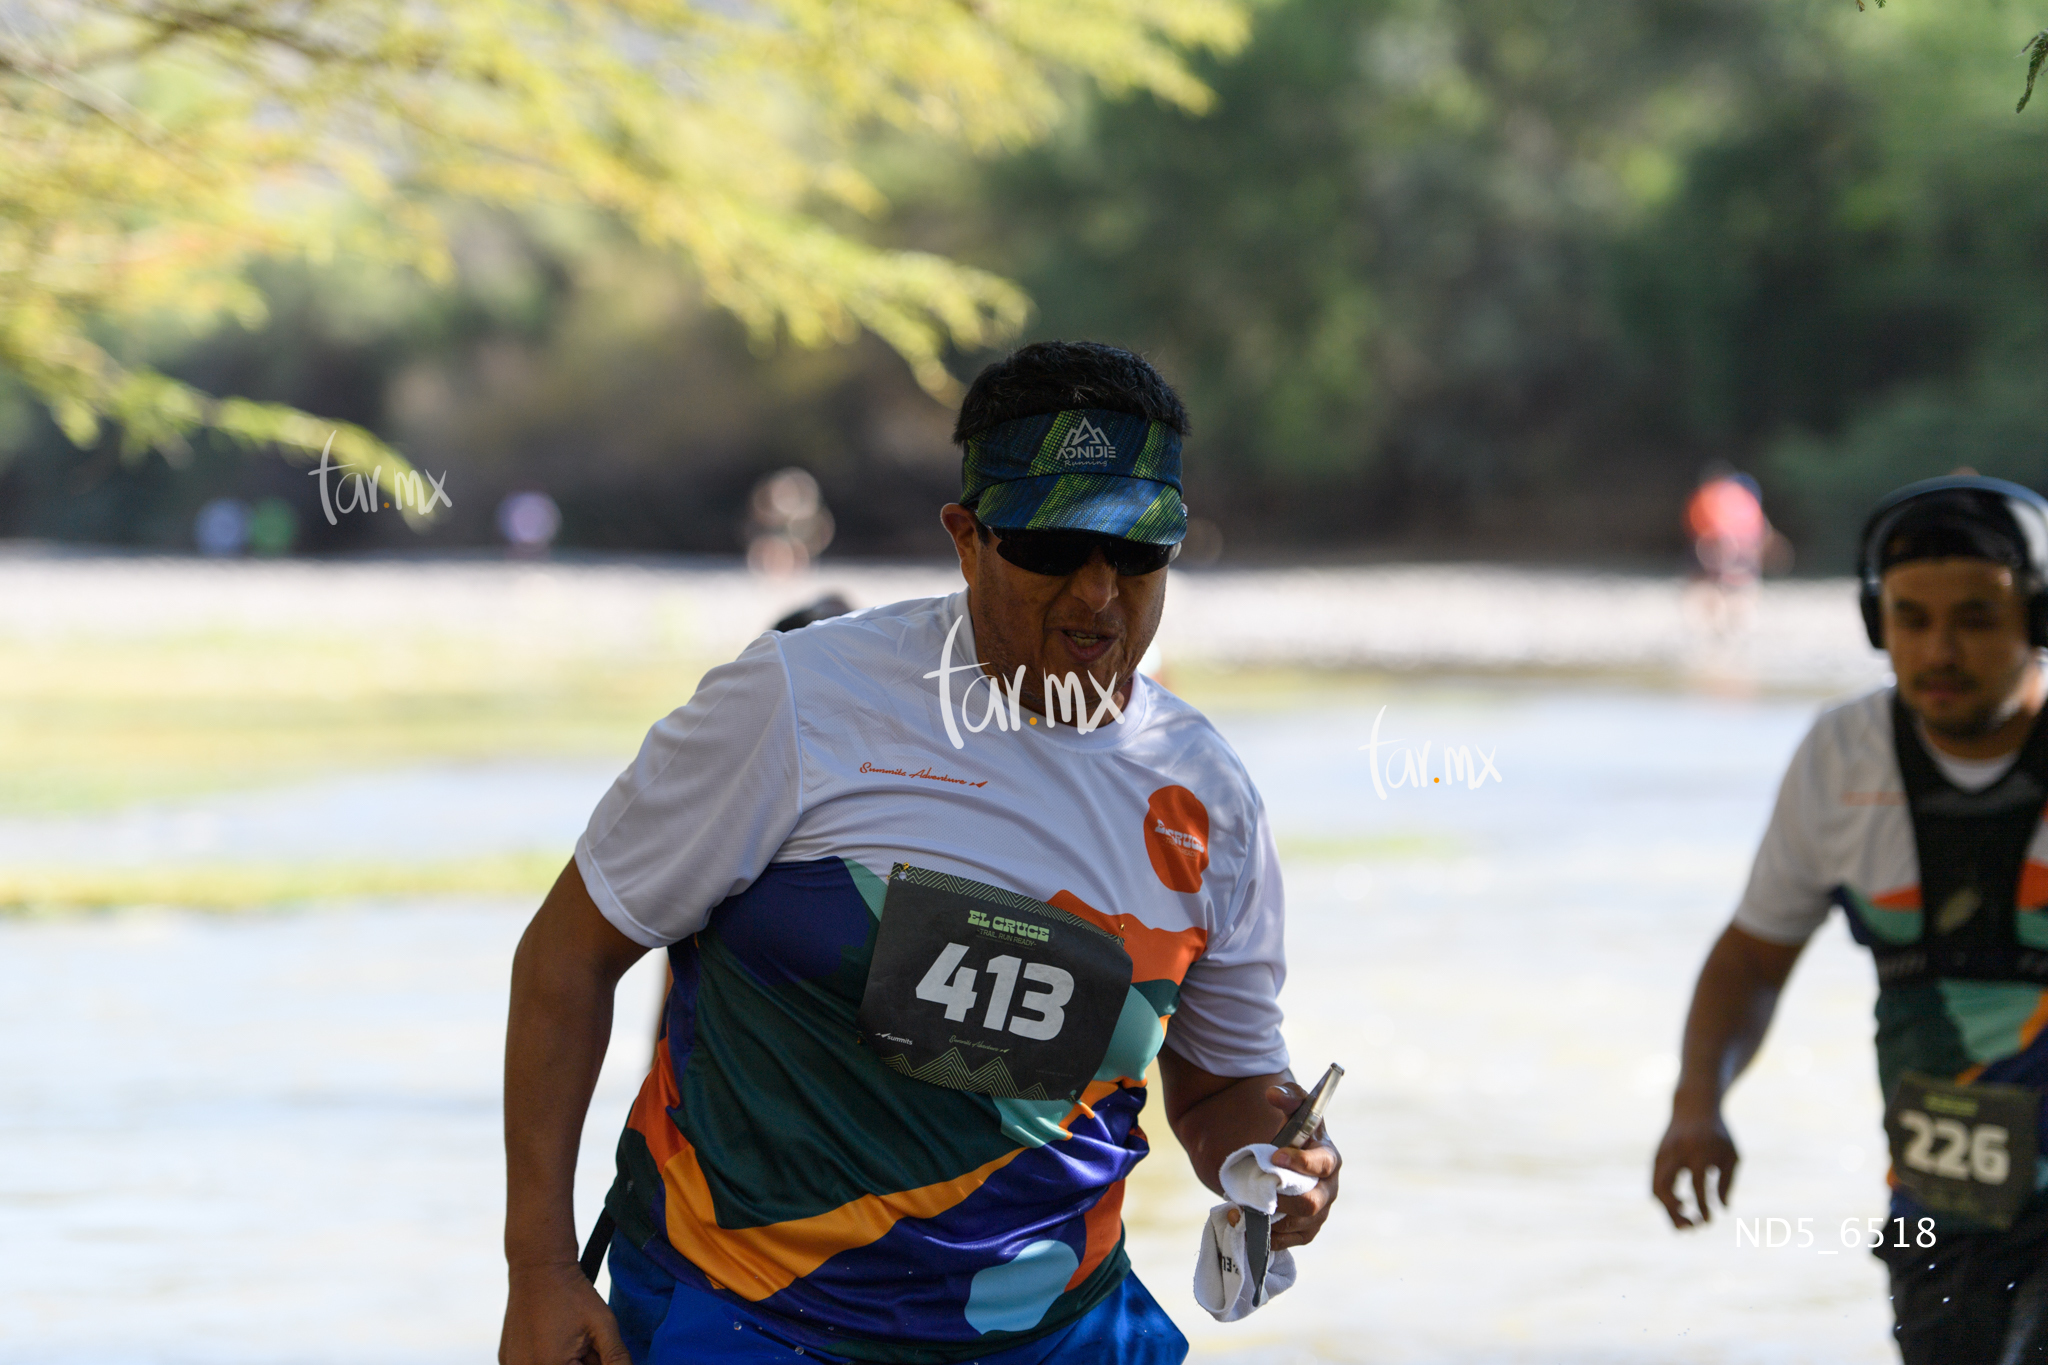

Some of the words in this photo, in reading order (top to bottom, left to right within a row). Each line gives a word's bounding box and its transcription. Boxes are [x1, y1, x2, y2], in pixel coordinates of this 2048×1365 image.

[860, 762, 907, 777] Summits
[909, 767, 967, 785] Adventure
[967, 909, 990, 928] EL
[992, 916, 1050, 943] CRUCE
[915, 942, 1075, 1041] 413
[887, 1035, 913, 1046] summits
[1901, 1109, 2011, 1185] 226
